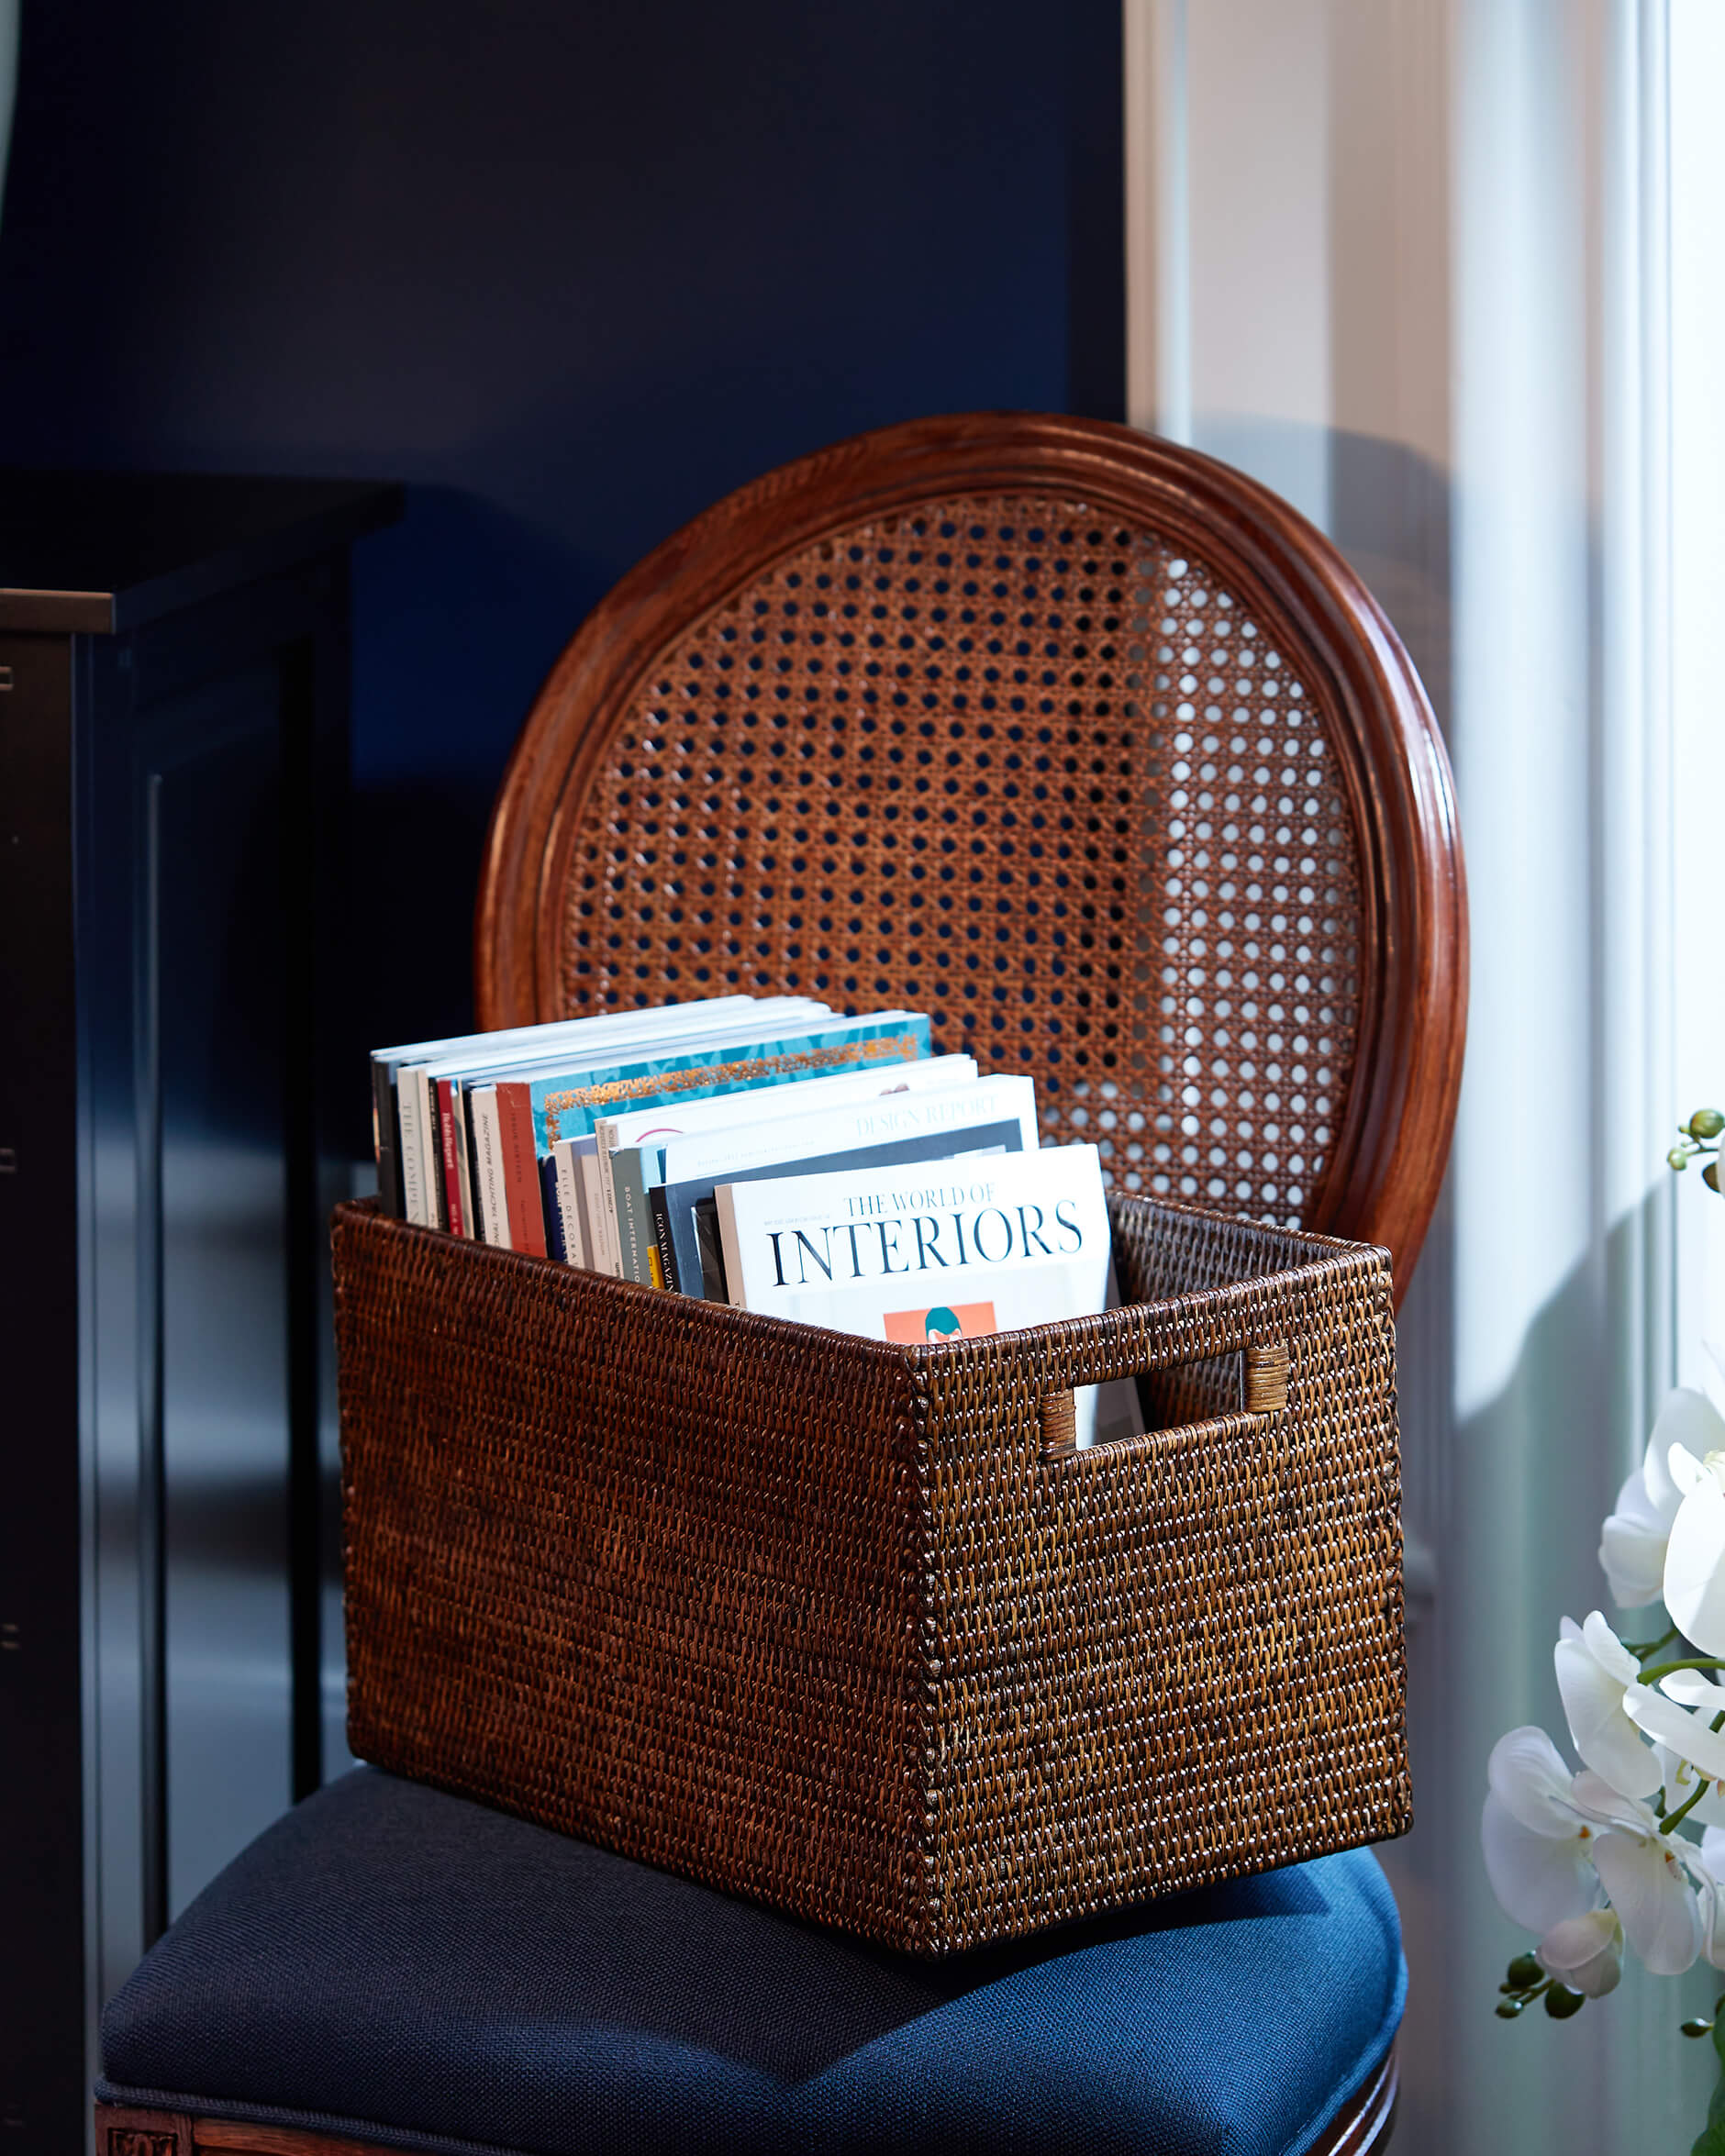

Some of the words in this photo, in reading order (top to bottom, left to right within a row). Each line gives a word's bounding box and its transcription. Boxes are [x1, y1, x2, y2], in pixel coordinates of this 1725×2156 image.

[402, 1103, 413, 1138] THE
[854, 1107, 920, 1139] DESIGN
[925, 1094, 998, 1125] REPORT
[482, 1113, 493, 1166] MAGAZINE
[487, 1168, 499, 1217] YACHTING
[561, 1169, 570, 1196] ELLE
[624, 1185, 634, 1214] BOAT
[843, 1194, 889, 1217] THE
[892, 1186, 964, 1212] WORLD
[970, 1182, 996, 1205] OF
[655, 1212, 666, 1240] ICON
[765, 1199, 1083, 1287] INTERIORS
[628, 1217, 641, 1283] INTERNATIO
